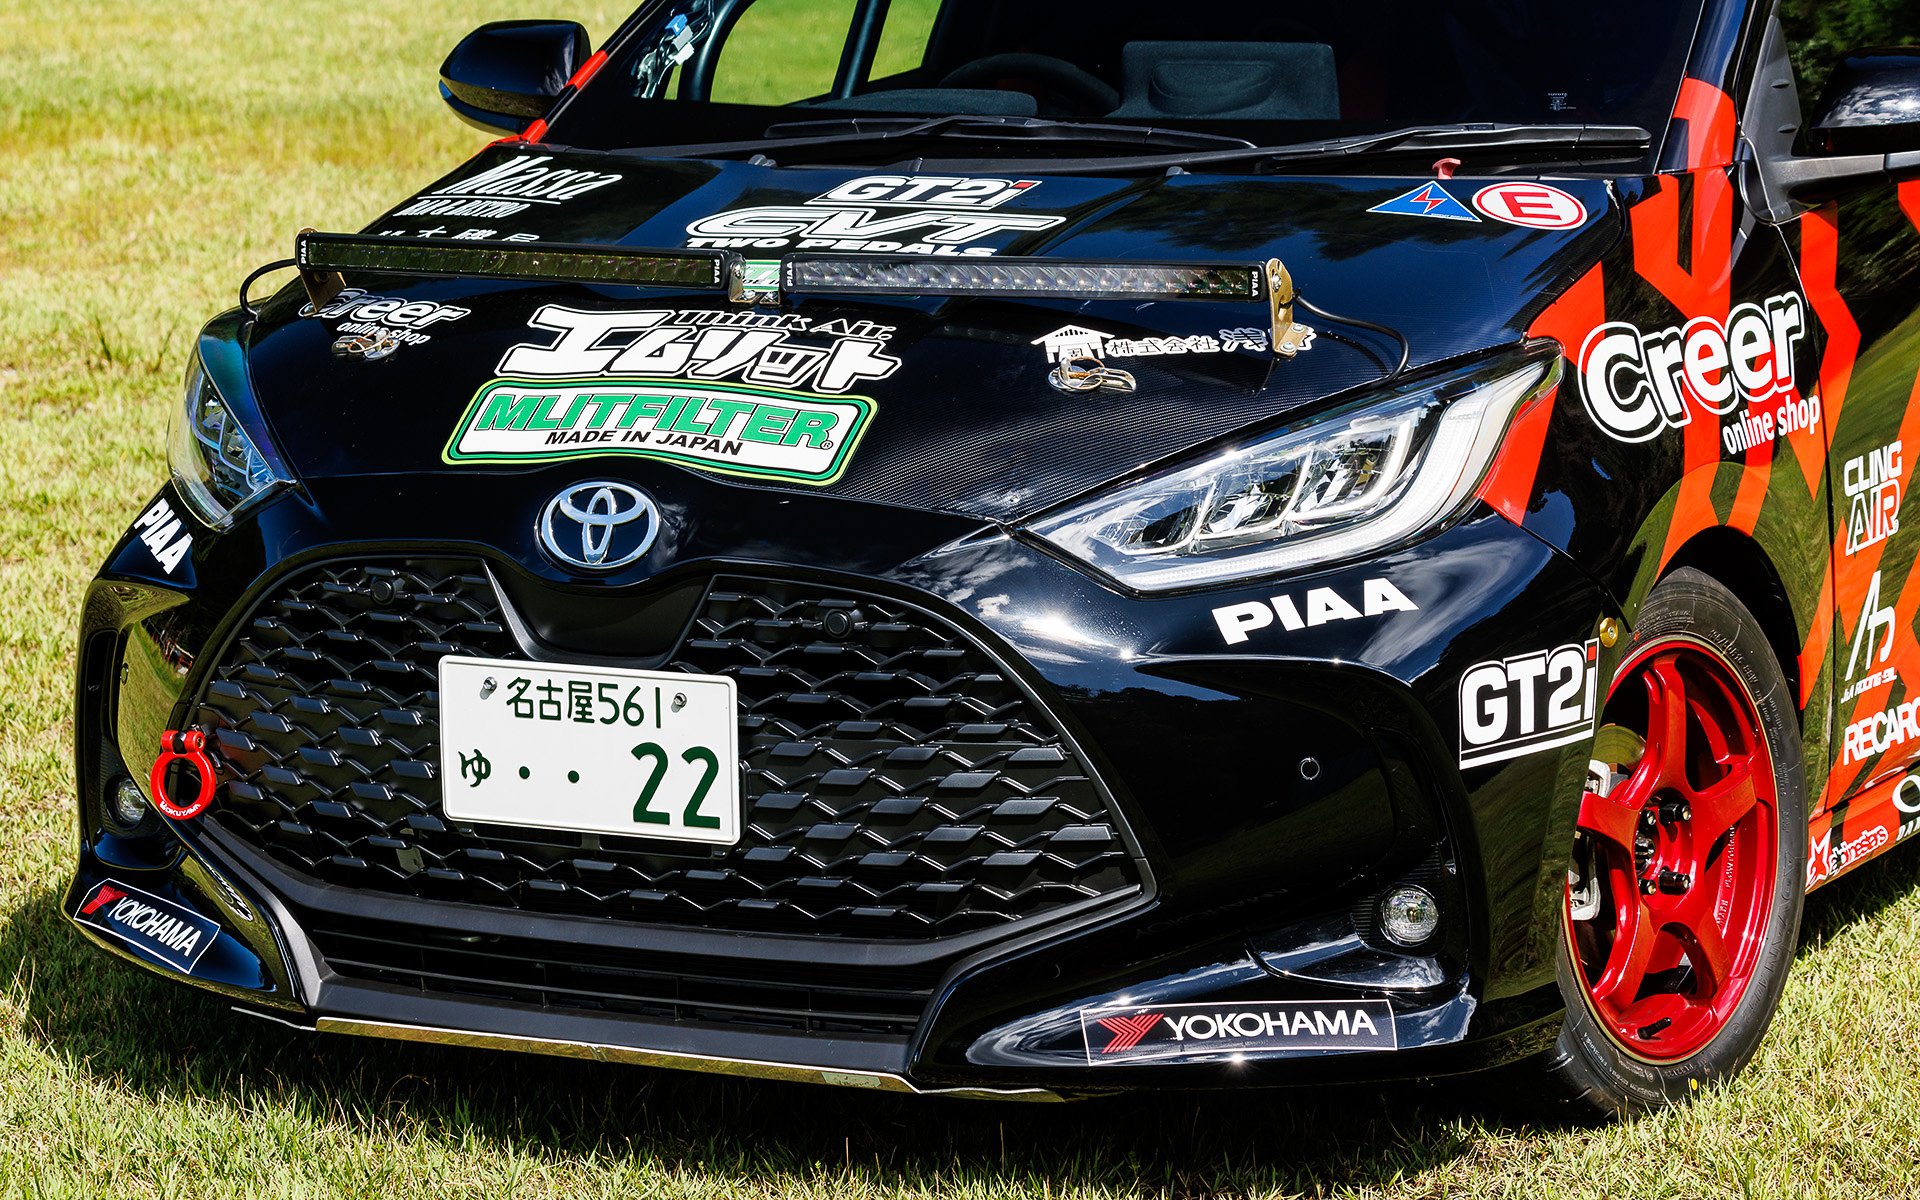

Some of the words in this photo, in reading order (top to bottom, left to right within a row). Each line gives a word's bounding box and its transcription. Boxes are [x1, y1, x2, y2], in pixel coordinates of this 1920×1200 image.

[822, 177, 1040, 208] GT2i
[1499, 191, 1562, 221] E
[686, 206, 1067, 244] CVT
[687, 236, 790, 249] TWO
[795, 239, 999, 256] PEDALS
[786, 261, 794, 287] PIAA
[1251, 271, 1259, 297] PIAA
[1578, 291, 1806, 443] Creer
[544, 430, 613, 445] MADE
[622, 431, 650, 443] IN
[655, 432, 743, 456] JAPAN
[1722, 411, 1775, 455] online
[1776, 395, 1820, 436] shop
[1843, 439, 1903, 497] CLING
[133, 497, 194, 575] PIAA
[1211, 577, 1419, 645] PIAA
[1459, 640, 1600, 754] GT2i
[630, 741, 721, 829] 22
[107, 896, 202, 957] YOKOHAMA
[1163, 1009, 1379, 1041] YOKOHAMA
